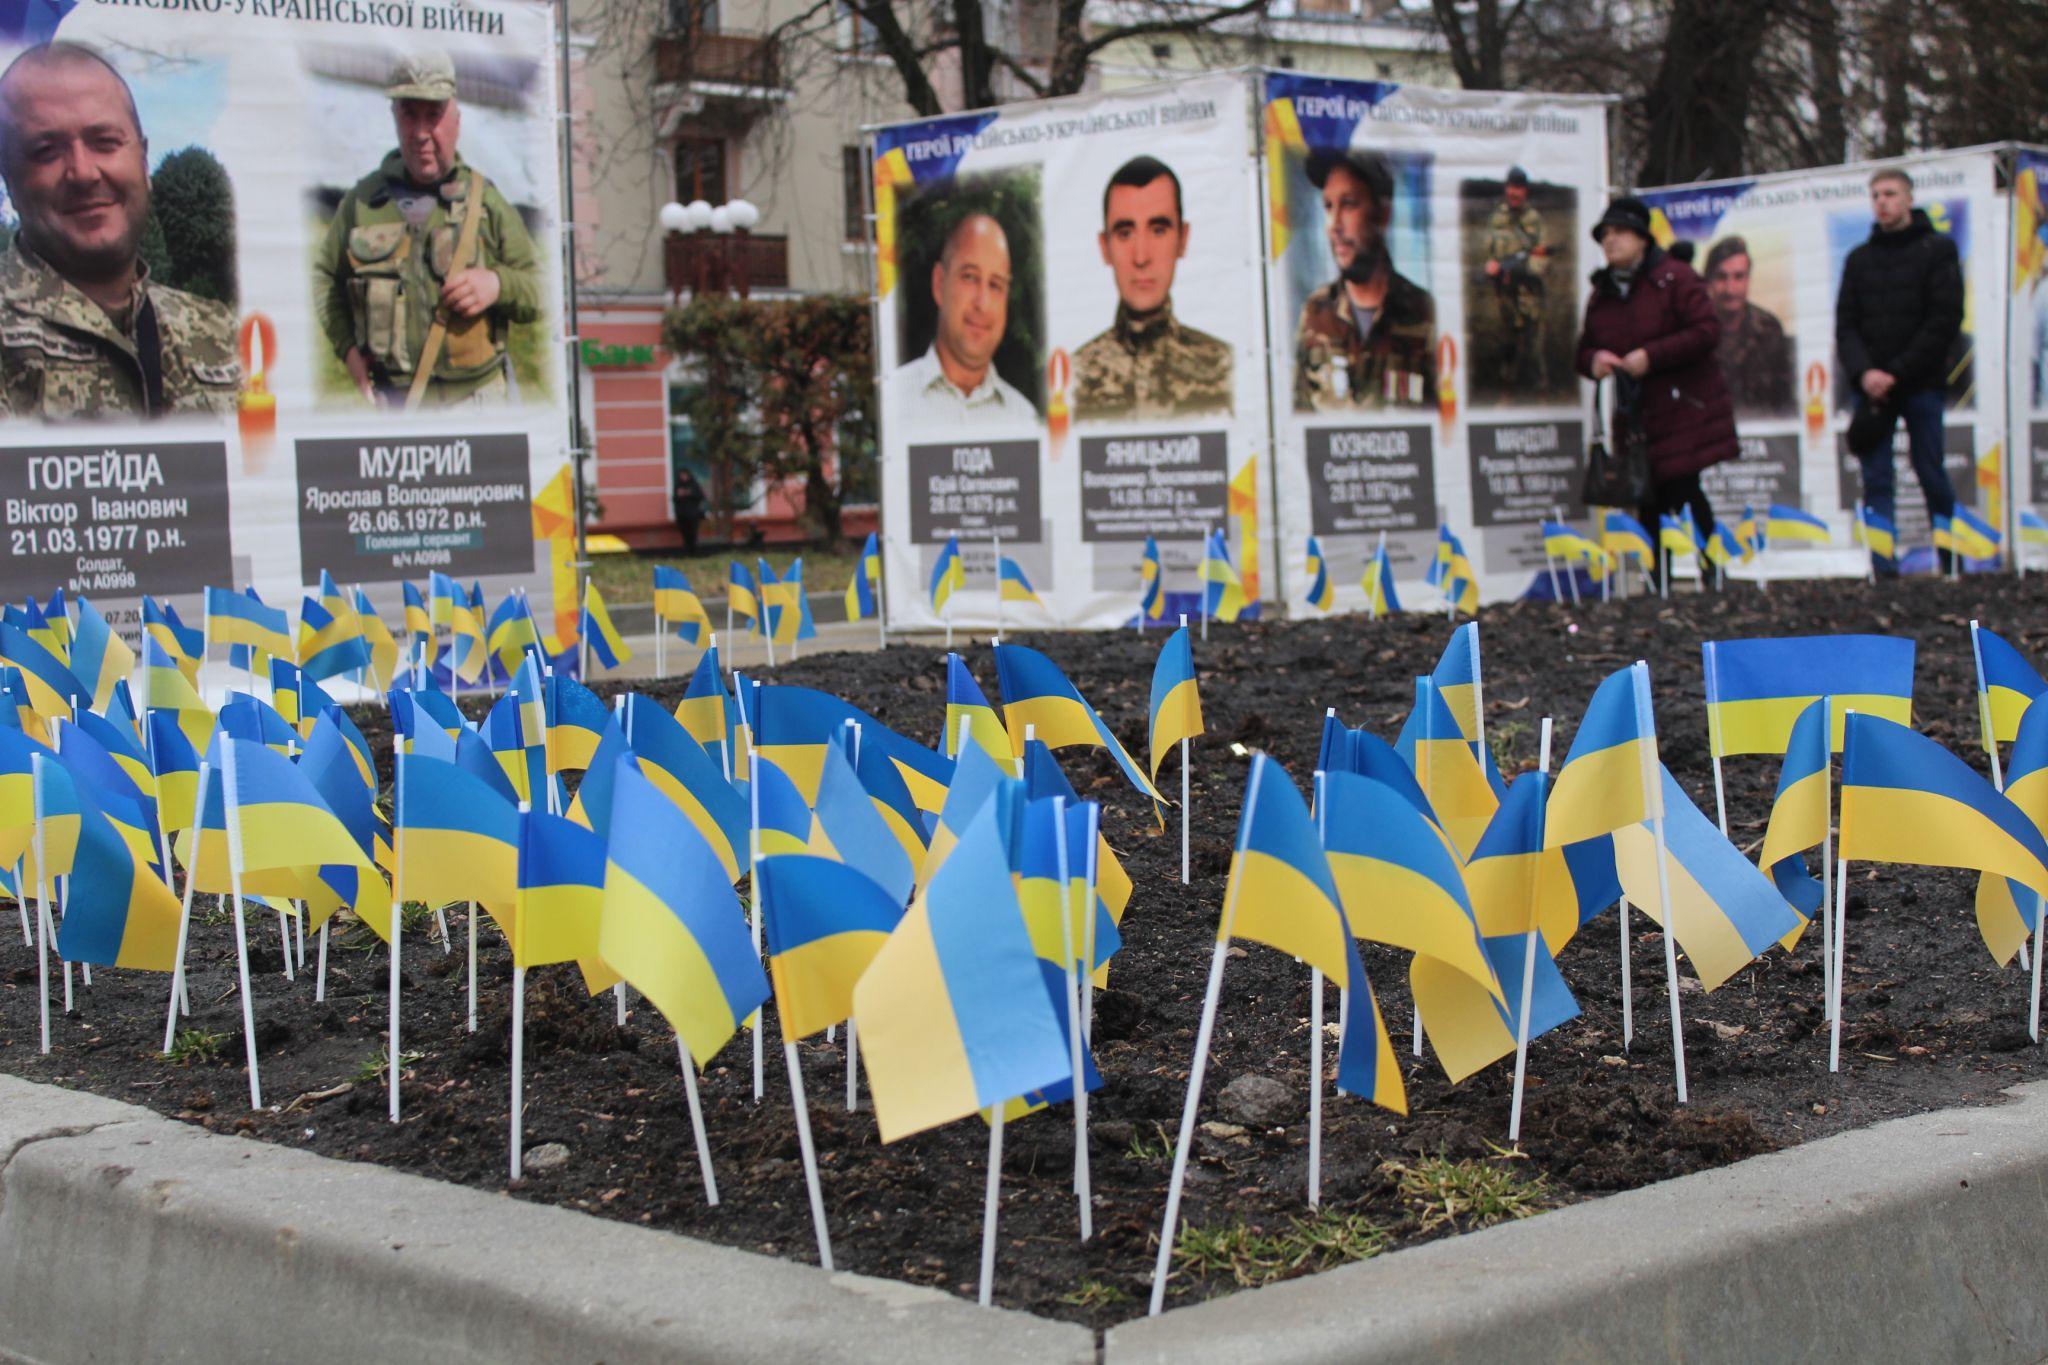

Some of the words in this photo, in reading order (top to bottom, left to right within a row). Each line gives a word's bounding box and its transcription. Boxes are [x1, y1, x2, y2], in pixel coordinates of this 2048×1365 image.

[422, 3, 504, 35] ВІЙНИ
[1296, 94, 1345, 119] ГЕРОЇ
[906, 133, 951, 162] ГЕРОЇ
[28, 449, 164, 493] ГОРЕЙДА
[359, 440, 472, 482] МУДРИЙ
[6, 498, 78, 526] Віктор
[91, 496, 188, 521] Іванович
[306, 486, 382, 513] Ярослав
[387, 483, 524, 507] Володимирович
[348, 508, 449, 533] 26.06.1972
[454, 511, 486, 529] р.н.
[11, 525, 138, 555] 21.03.1977
[146, 528, 186, 554] р.н.
[365, 533, 420, 550] Головний
[422, 532, 470, 548] сержант
[76, 556, 126, 573] Солдат,
[69, 576, 91, 592] в/ч
